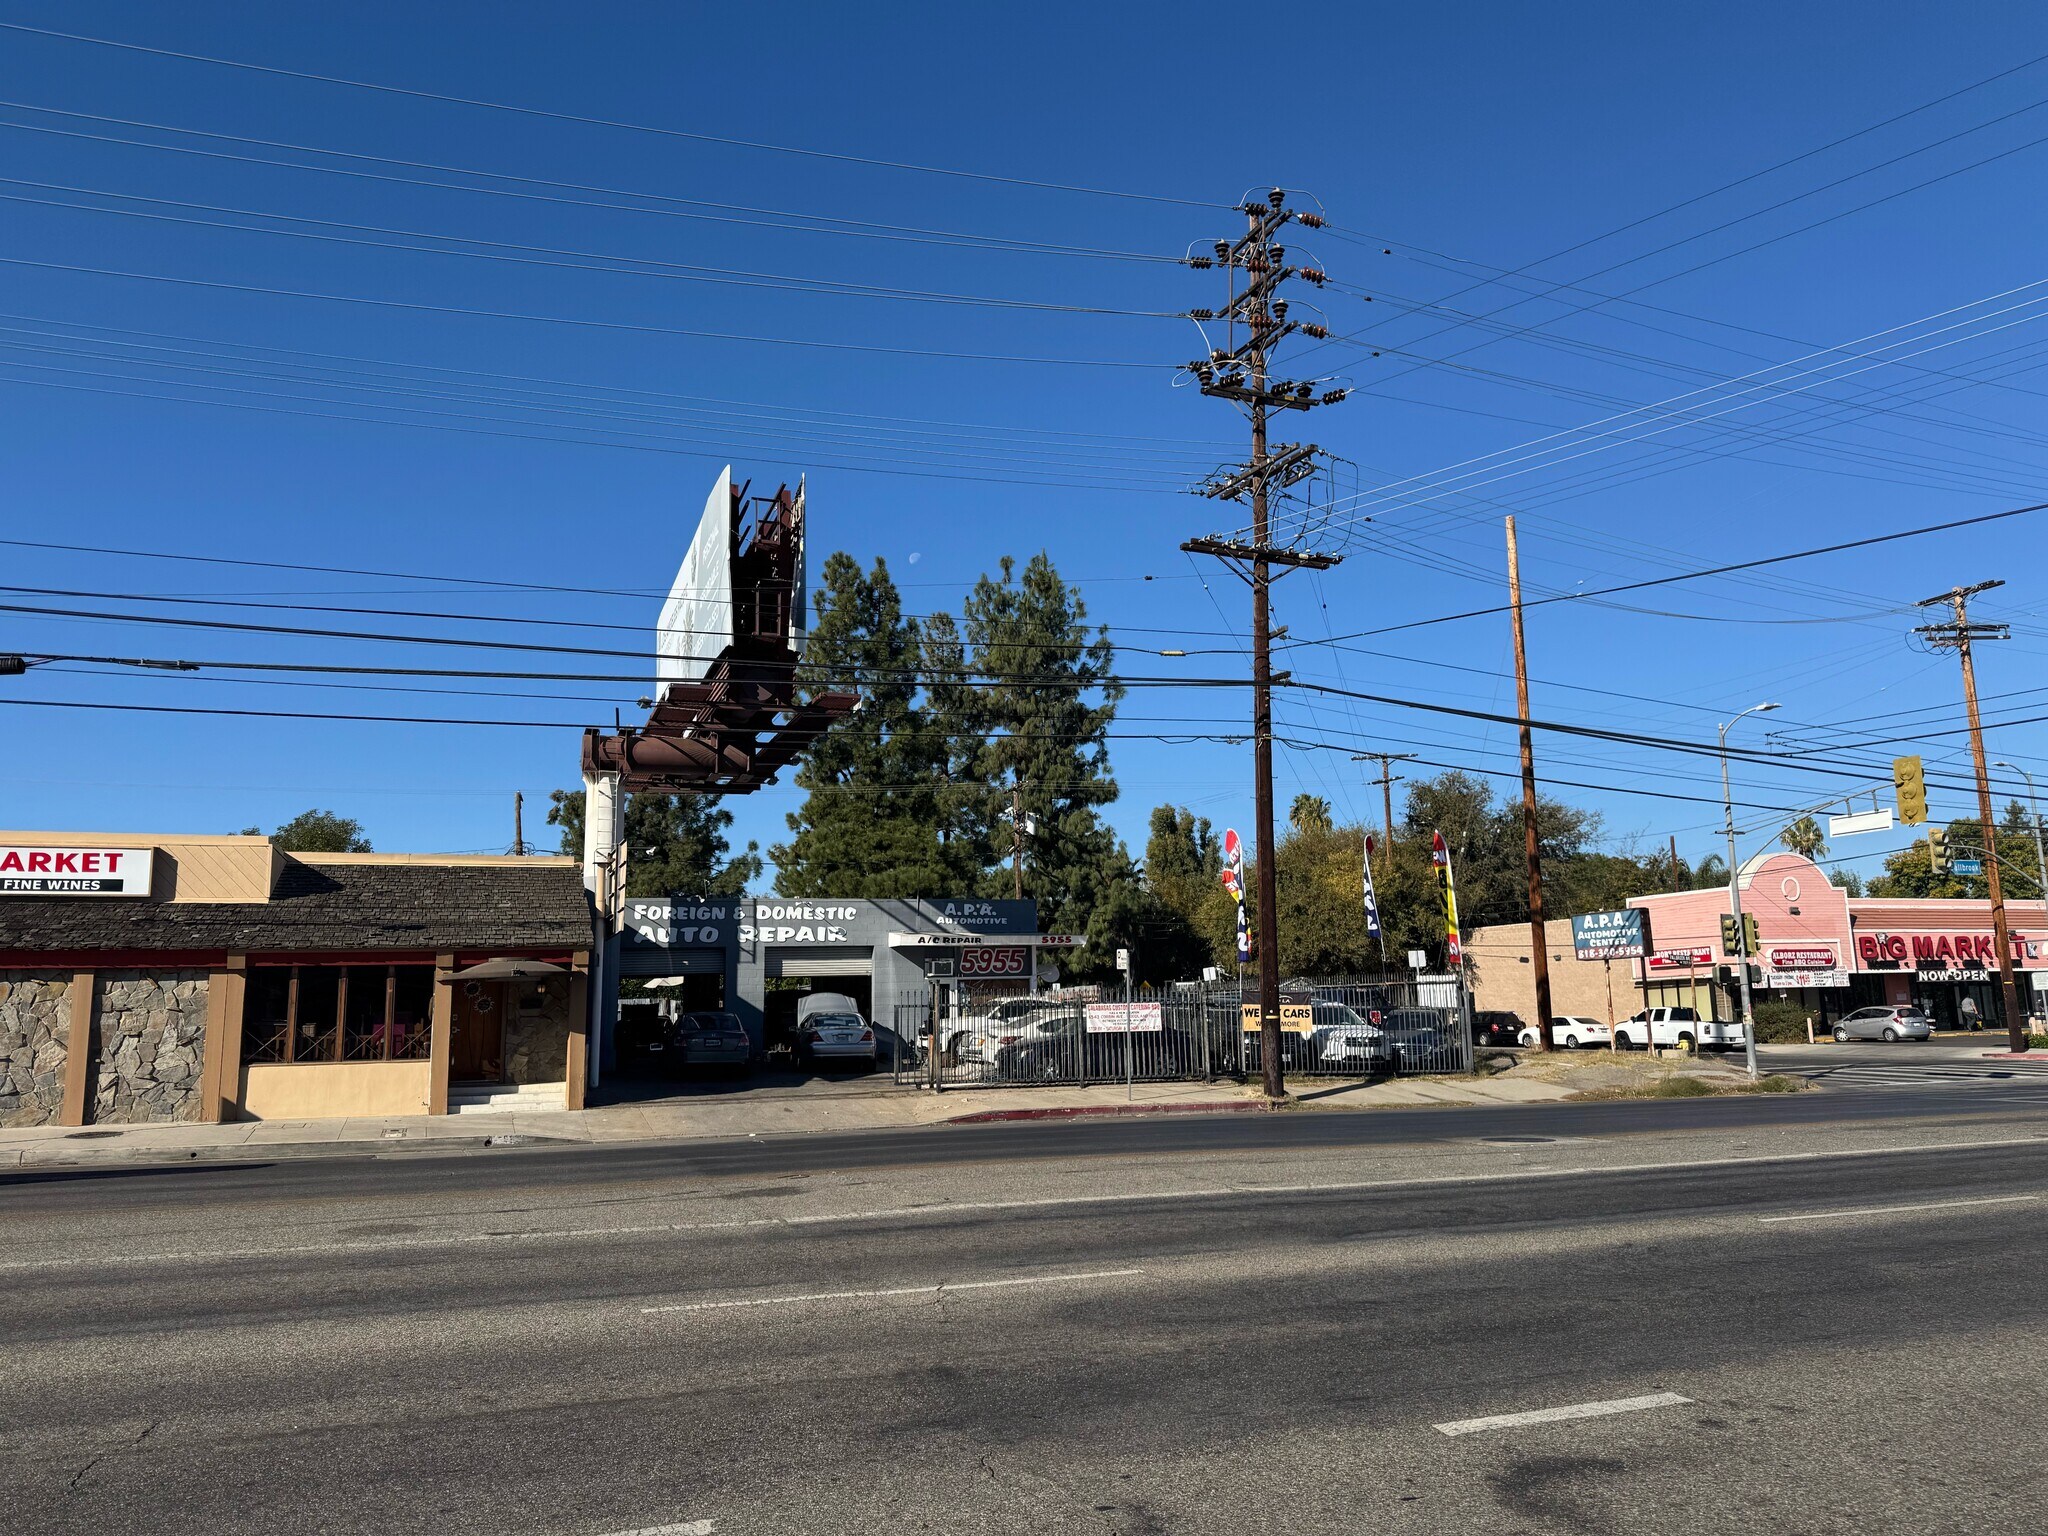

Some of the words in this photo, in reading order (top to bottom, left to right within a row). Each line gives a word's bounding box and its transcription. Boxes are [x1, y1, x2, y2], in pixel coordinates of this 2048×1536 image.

[0, 852, 124, 873] ARKET
[1953, 863, 1979, 872] allbrook
[3, 879, 41, 890] FINE
[47, 880, 100, 891] WINES
[633, 904, 726, 921] FOREIGN
[733, 906, 746, 921] &
[755, 905, 857, 921] DOMESTIC
[936, 916, 1008, 925] AUTOMOTIVE
[1583, 912, 1629, 929] A.P.A.
[633, 925, 719, 944] AUTO
[736, 925, 847, 943] REPAIR
[1041, 936, 1072, 944] 5955
[1577, 928, 1639, 940] AUTOMOTIVE
[1589, 937, 1627, 947] CENTER
[1859, 935, 1906, 959] BIG
[1911, 935, 2025, 959] MARKT
[960, 948, 1026, 974] 5955
[1796, 951, 1831, 959] RESTAURANT
[1918, 971, 1949, 981] NOW
[1953, 971, 1989, 981] OPEN
[1244, 1008, 1260, 1017] WE
[1283, 1009, 1310, 1018] CARS
